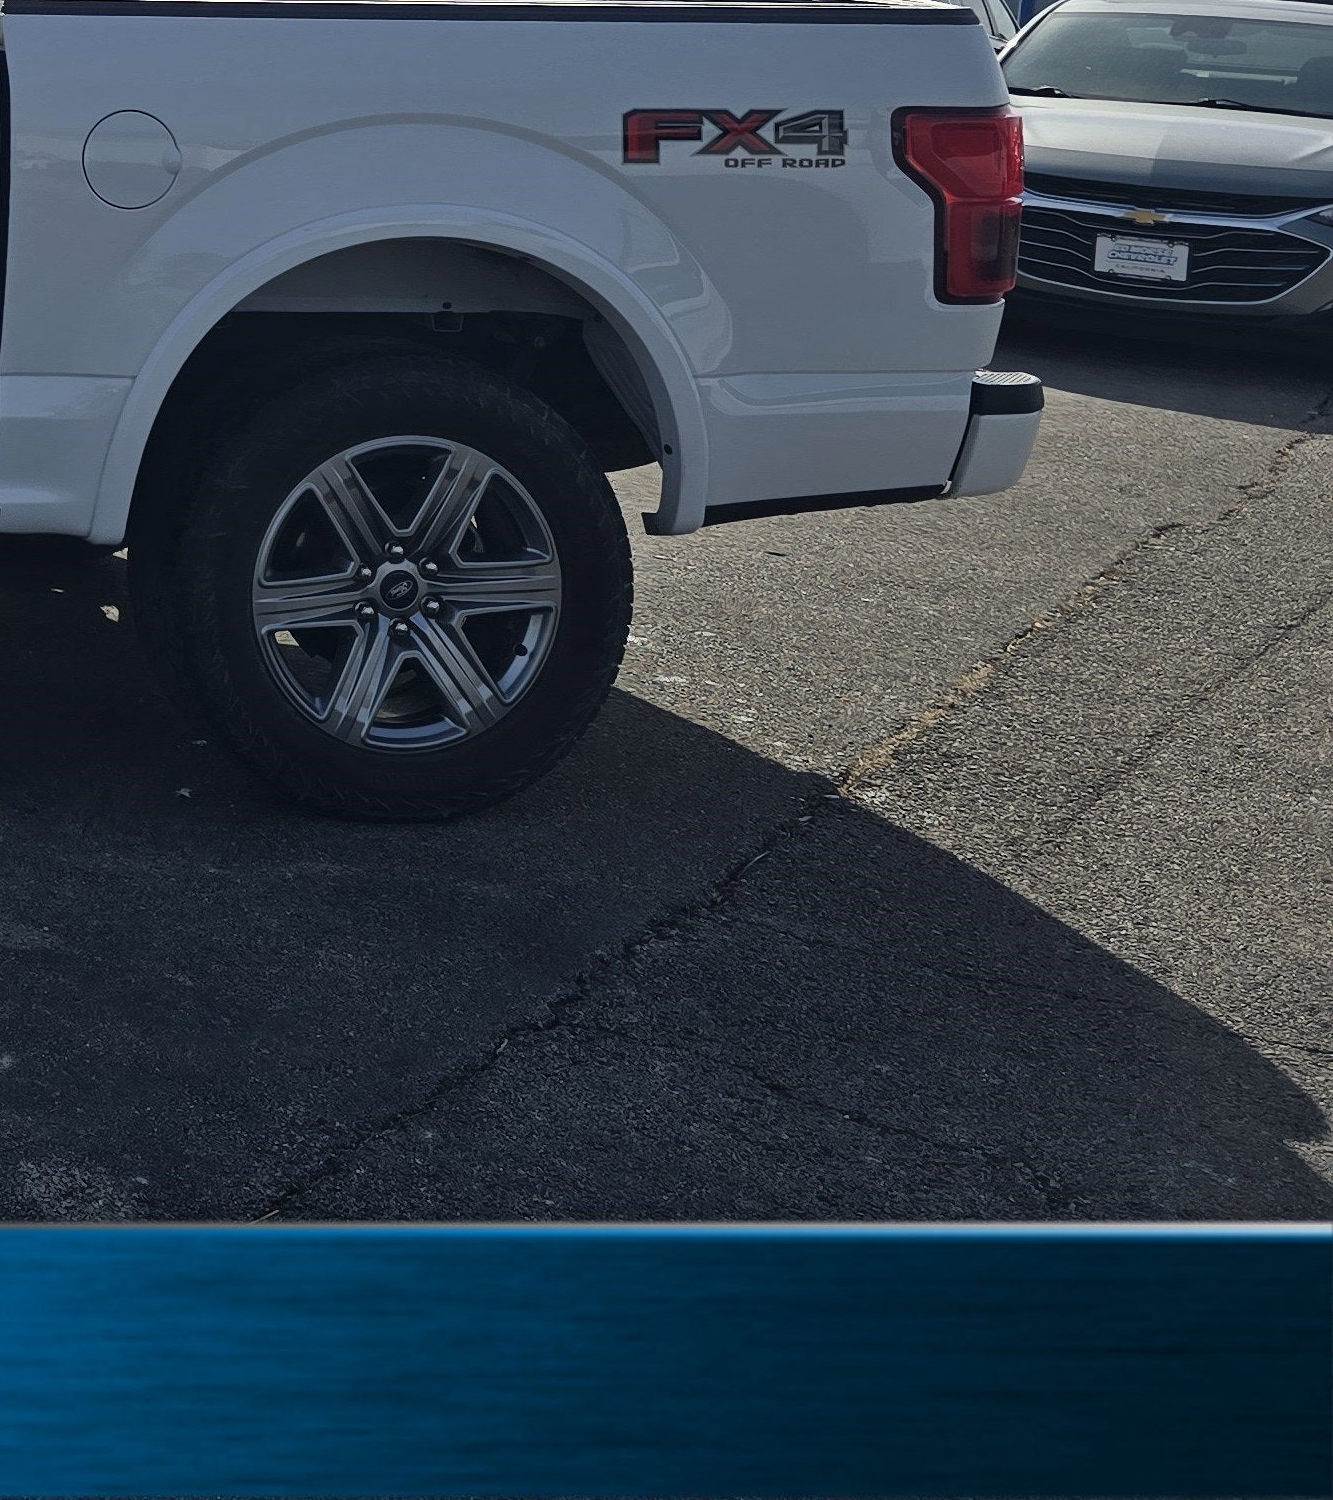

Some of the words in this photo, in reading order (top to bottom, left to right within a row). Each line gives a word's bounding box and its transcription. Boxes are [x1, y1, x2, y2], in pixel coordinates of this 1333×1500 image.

[622, 107, 849, 165] FX4
[723, 157, 773, 169] OFF
[782, 157, 847, 169] ROAD
[1107, 250, 1178, 266] CHEVROLET
